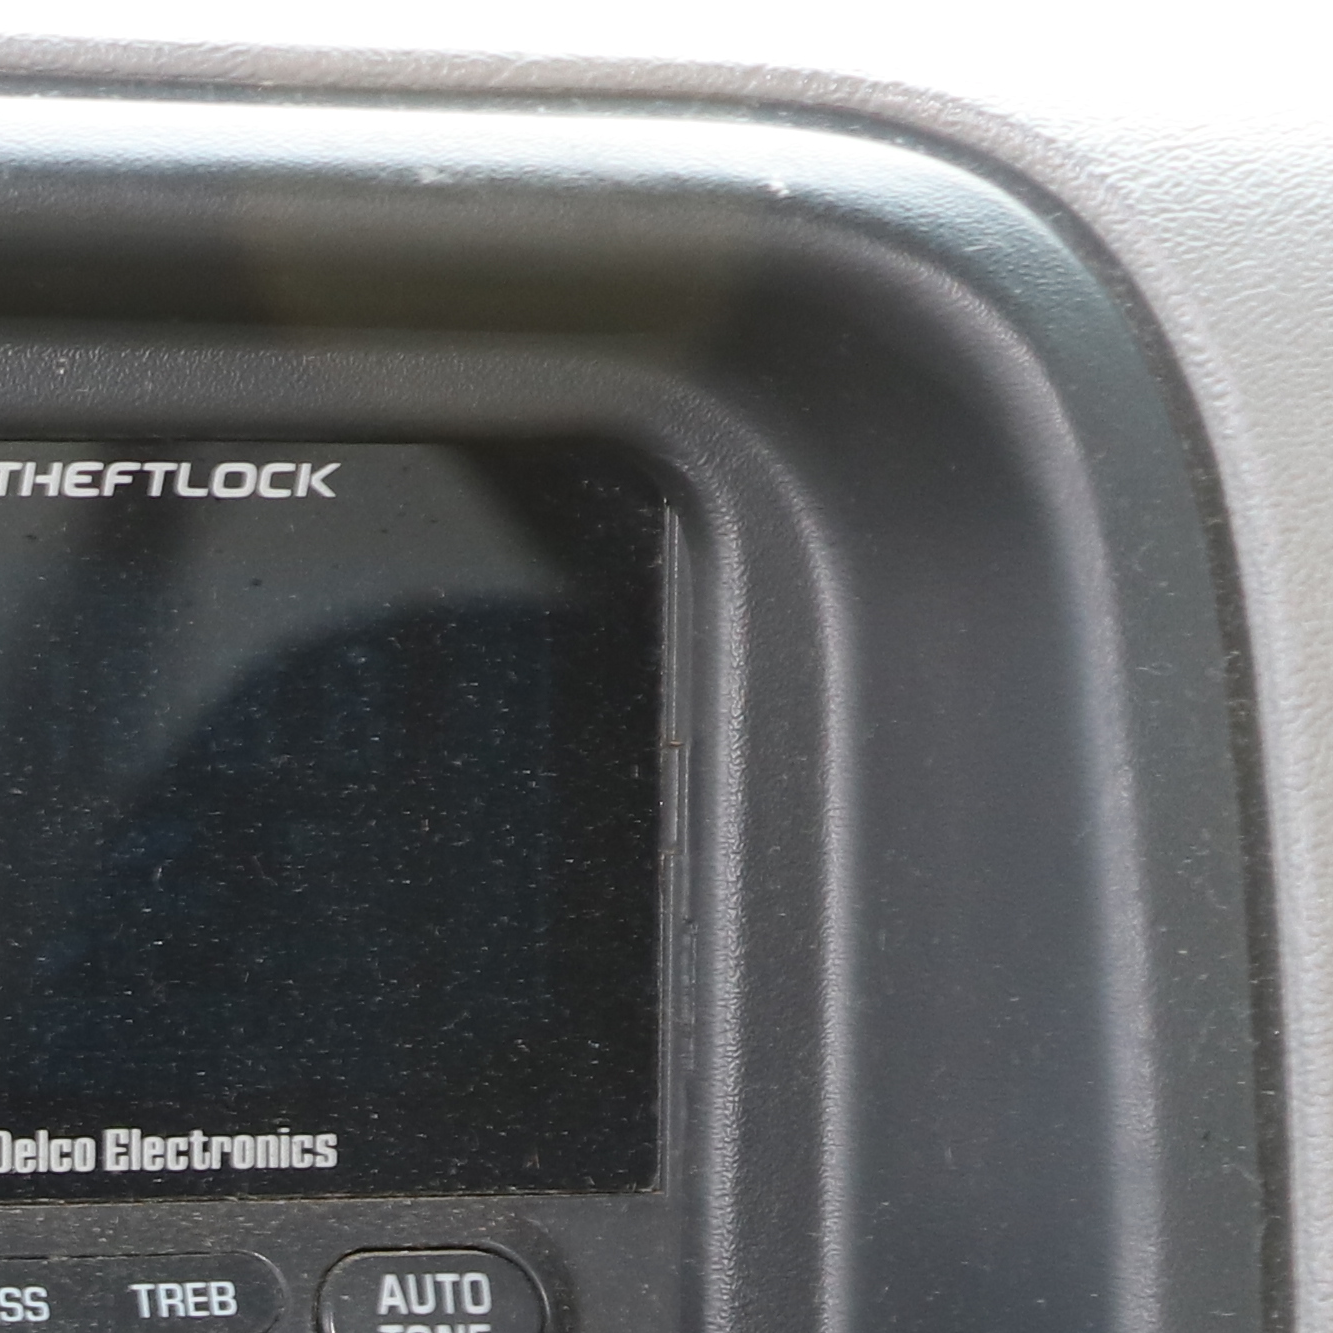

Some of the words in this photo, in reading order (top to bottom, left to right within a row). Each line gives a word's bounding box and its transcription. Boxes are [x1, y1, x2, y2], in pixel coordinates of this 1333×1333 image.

[103, 1127, 339, 1171] Electronics
[129, 1281, 238, 1318] TREB
[377, 1272, 492, 1316] AUTO
